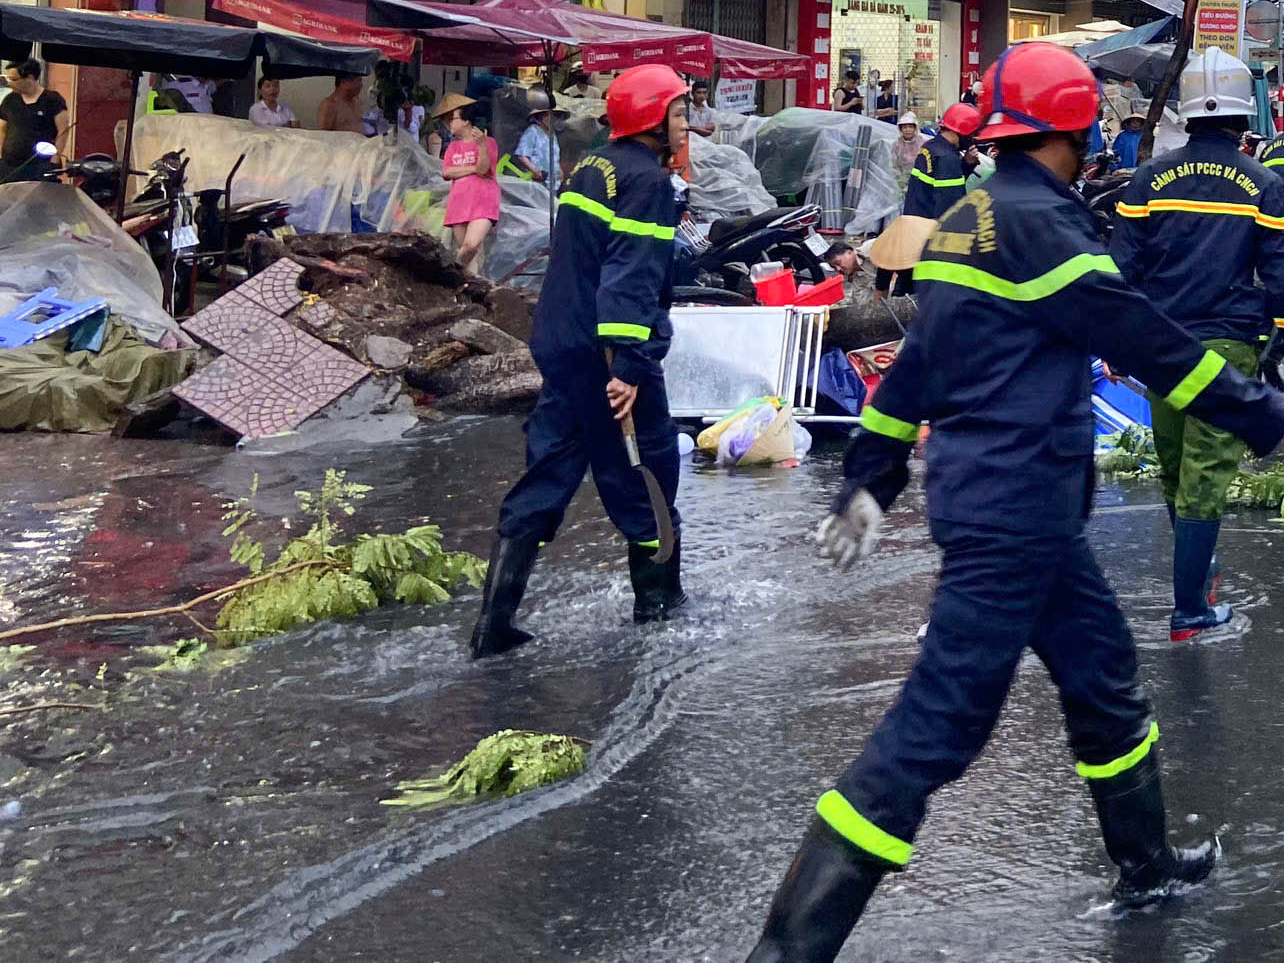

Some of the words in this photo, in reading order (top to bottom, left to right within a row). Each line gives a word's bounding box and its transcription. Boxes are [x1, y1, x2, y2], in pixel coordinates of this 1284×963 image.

[1150, 169, 1177, 192] CẢNH
[1177, 161, 1195, 177] SÁT
[1197, 162, 1222, 176] PCCC
[1223, 166, 1235, 181] VÀ
[1235, 173, 1260, 197] CNCH
